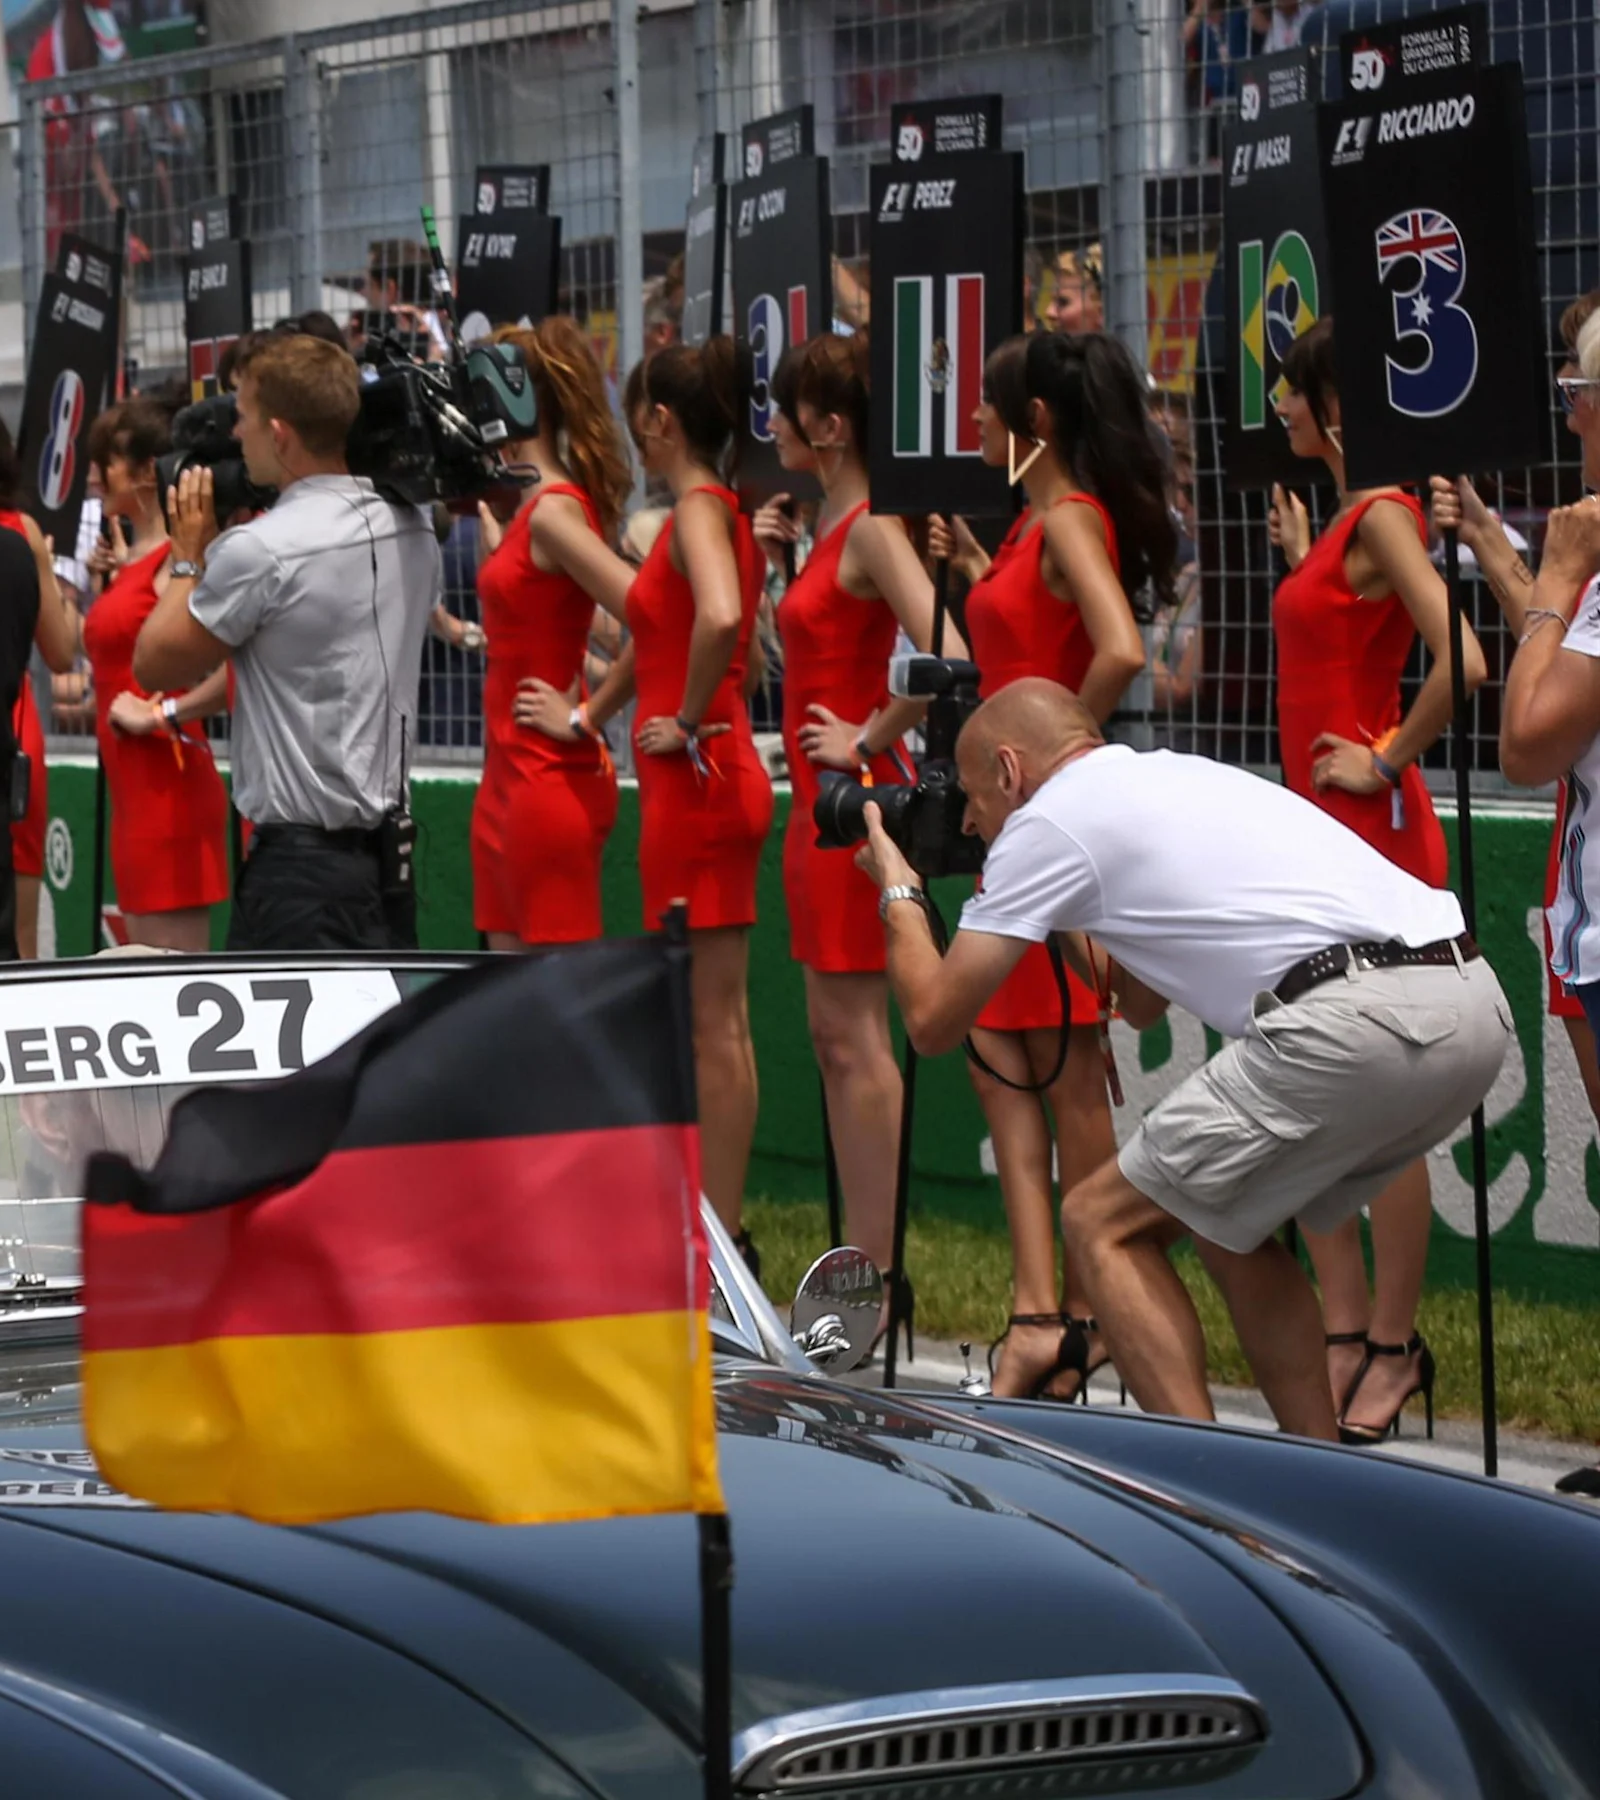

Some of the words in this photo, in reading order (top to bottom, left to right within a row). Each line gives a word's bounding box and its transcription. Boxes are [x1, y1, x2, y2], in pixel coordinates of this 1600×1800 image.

[1400, 27, 1448, 47] FORMULA
[1350, 50, 1385, 90] 50
[1419, 54, 1457, 72] CANADA
[1378, 94, 1475, 144] RICCIARDO
[1254, 134, 1291, 170] MASSA
[758, 188, 787, 222] OCON
[912, 179, 957, 210] PEREZ
[1375, 208, 1478, 417] 3
[893, 272, 984, 458] 11
[38, 368, 85, 511] 8
[176, 979, 313, 1074] 27
